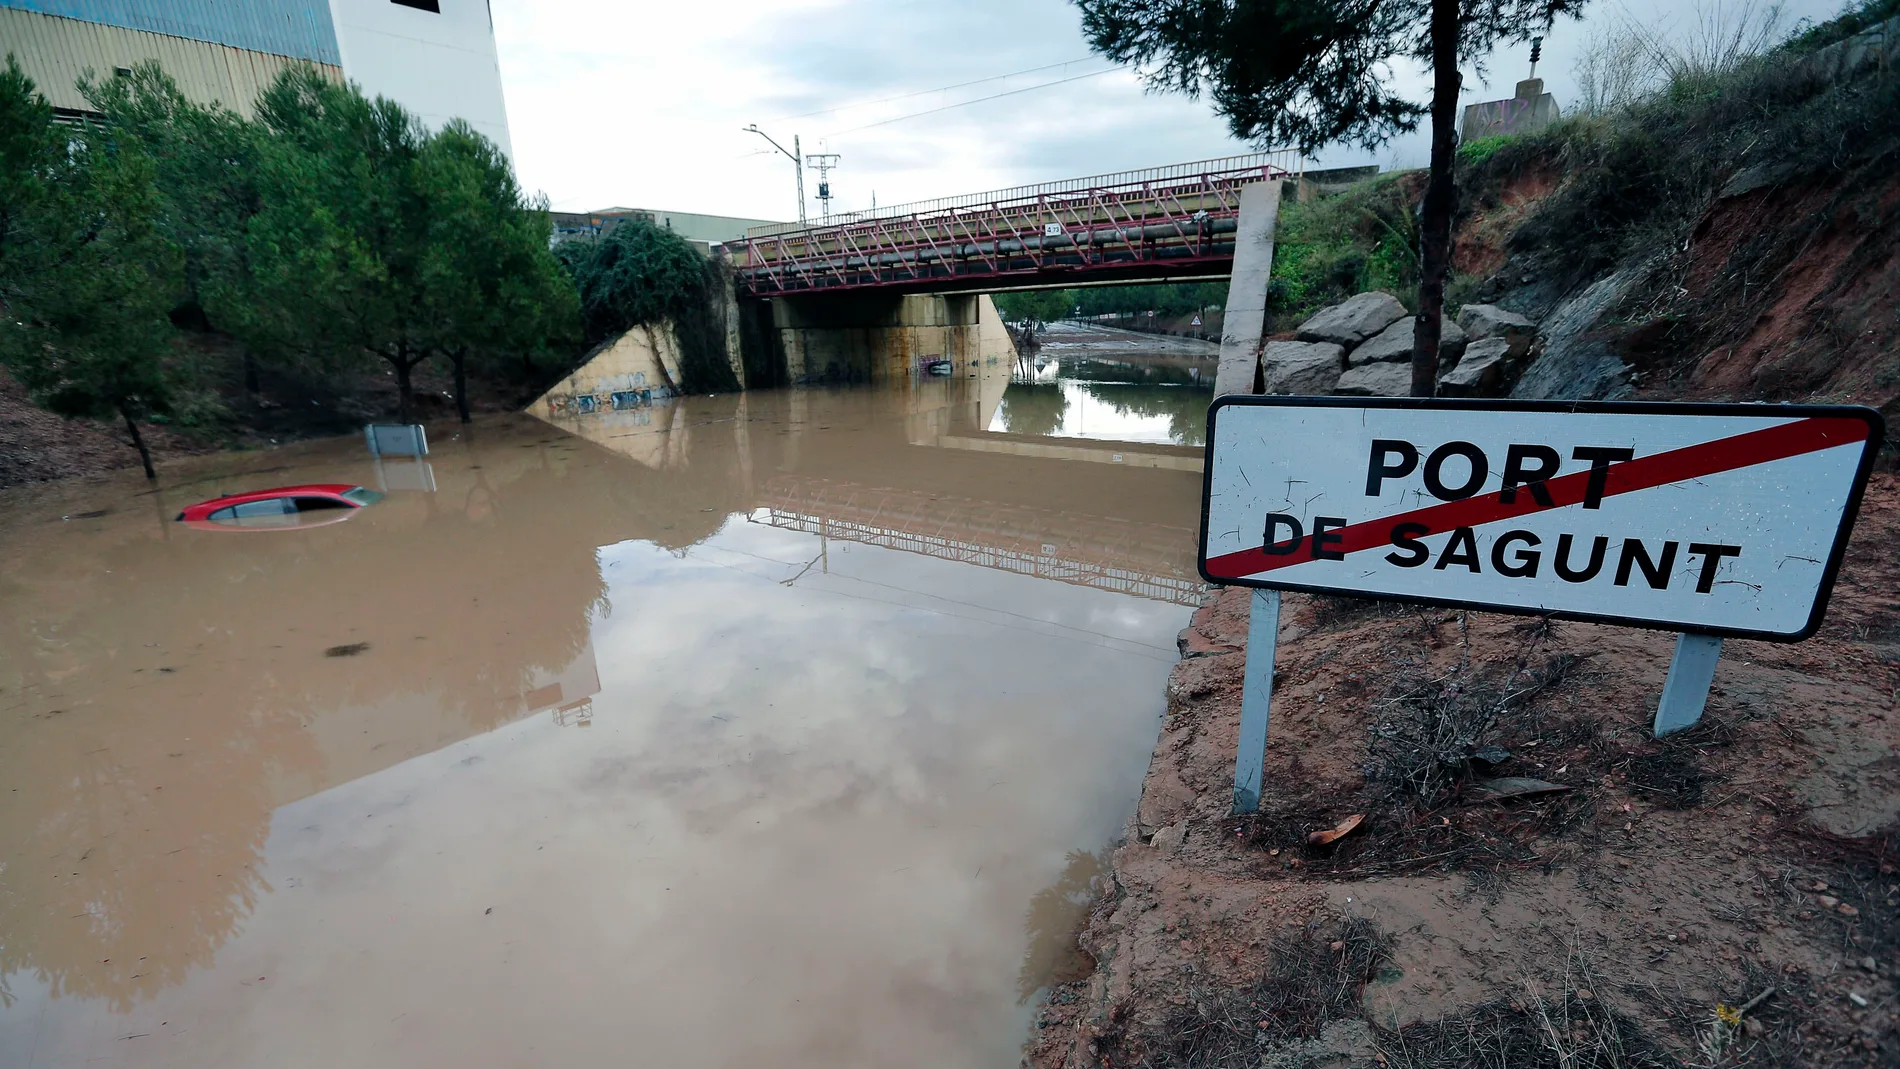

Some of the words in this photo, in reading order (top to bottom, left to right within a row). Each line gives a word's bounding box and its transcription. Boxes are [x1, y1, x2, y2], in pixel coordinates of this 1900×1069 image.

[1365, 439, 1635, 510] PORT
[1263, 512, 1347, 562] DE
[1384, 522, 1742, 594] SAGUNT
